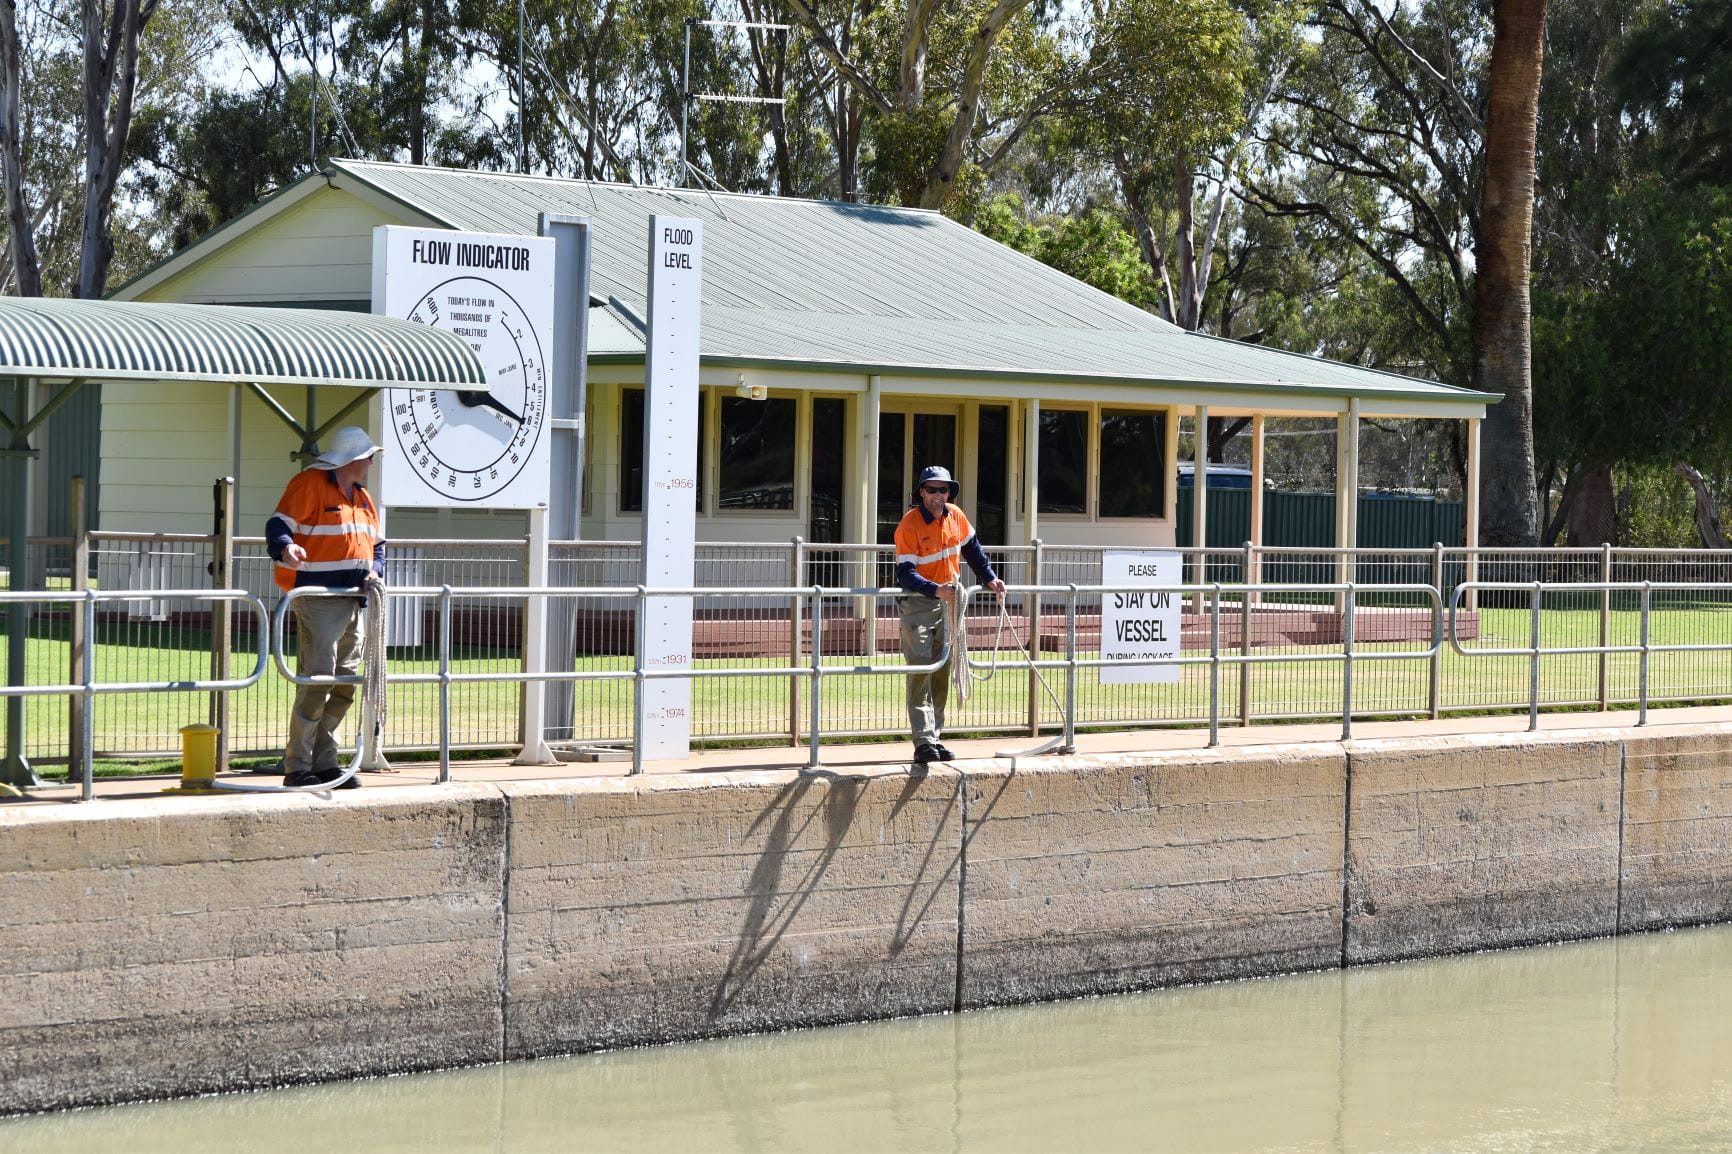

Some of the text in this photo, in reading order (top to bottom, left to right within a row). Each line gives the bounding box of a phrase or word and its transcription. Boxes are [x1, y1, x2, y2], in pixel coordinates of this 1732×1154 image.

[664, 228, 692, 245] FLOOD
[413, 240, 530, 271] FLOW INDICATOR
[664, 252, 692, 269] LEVEL
[427, 297, 438, 315] 400
[448, 296, 470, 306] TODAY'S
[472, 299, 486, 307] FLOW
[450, 312, 482, 322] THOUSANDS
[453, 328, 488, 338] MEGALITRES
[517, 329, 523, 338] 2
[528, 358, 534, 368] 3
[531, 383, 536, 392] 4
[395, 403, 407, 415] 100
[530, 402, 535, 411] 5
[401, 421, 411, 434] 80
[523, 428, 530, 437] 7
[519, 438, 525, 447] 8
[410, 443, 420, 456] 60
[419, 455, 429, 468] 50
[511, 453, 519, 464] 10
[430, 467, 440, 480] 40
[490, 469, 499, 480] 15
[448, 475, 457, 487] 30
[474, 476, 482, 488] 20
[672, 479, 694, 488] 1956
[1129, 565, 1157, 576] PLEASE
[1150, 592, 1169, 609] ON
[1116, 620, 1167, 642] VESSEL
[667, 655, 687, 664] 1931
[666, 708, 685, 718] 1974
